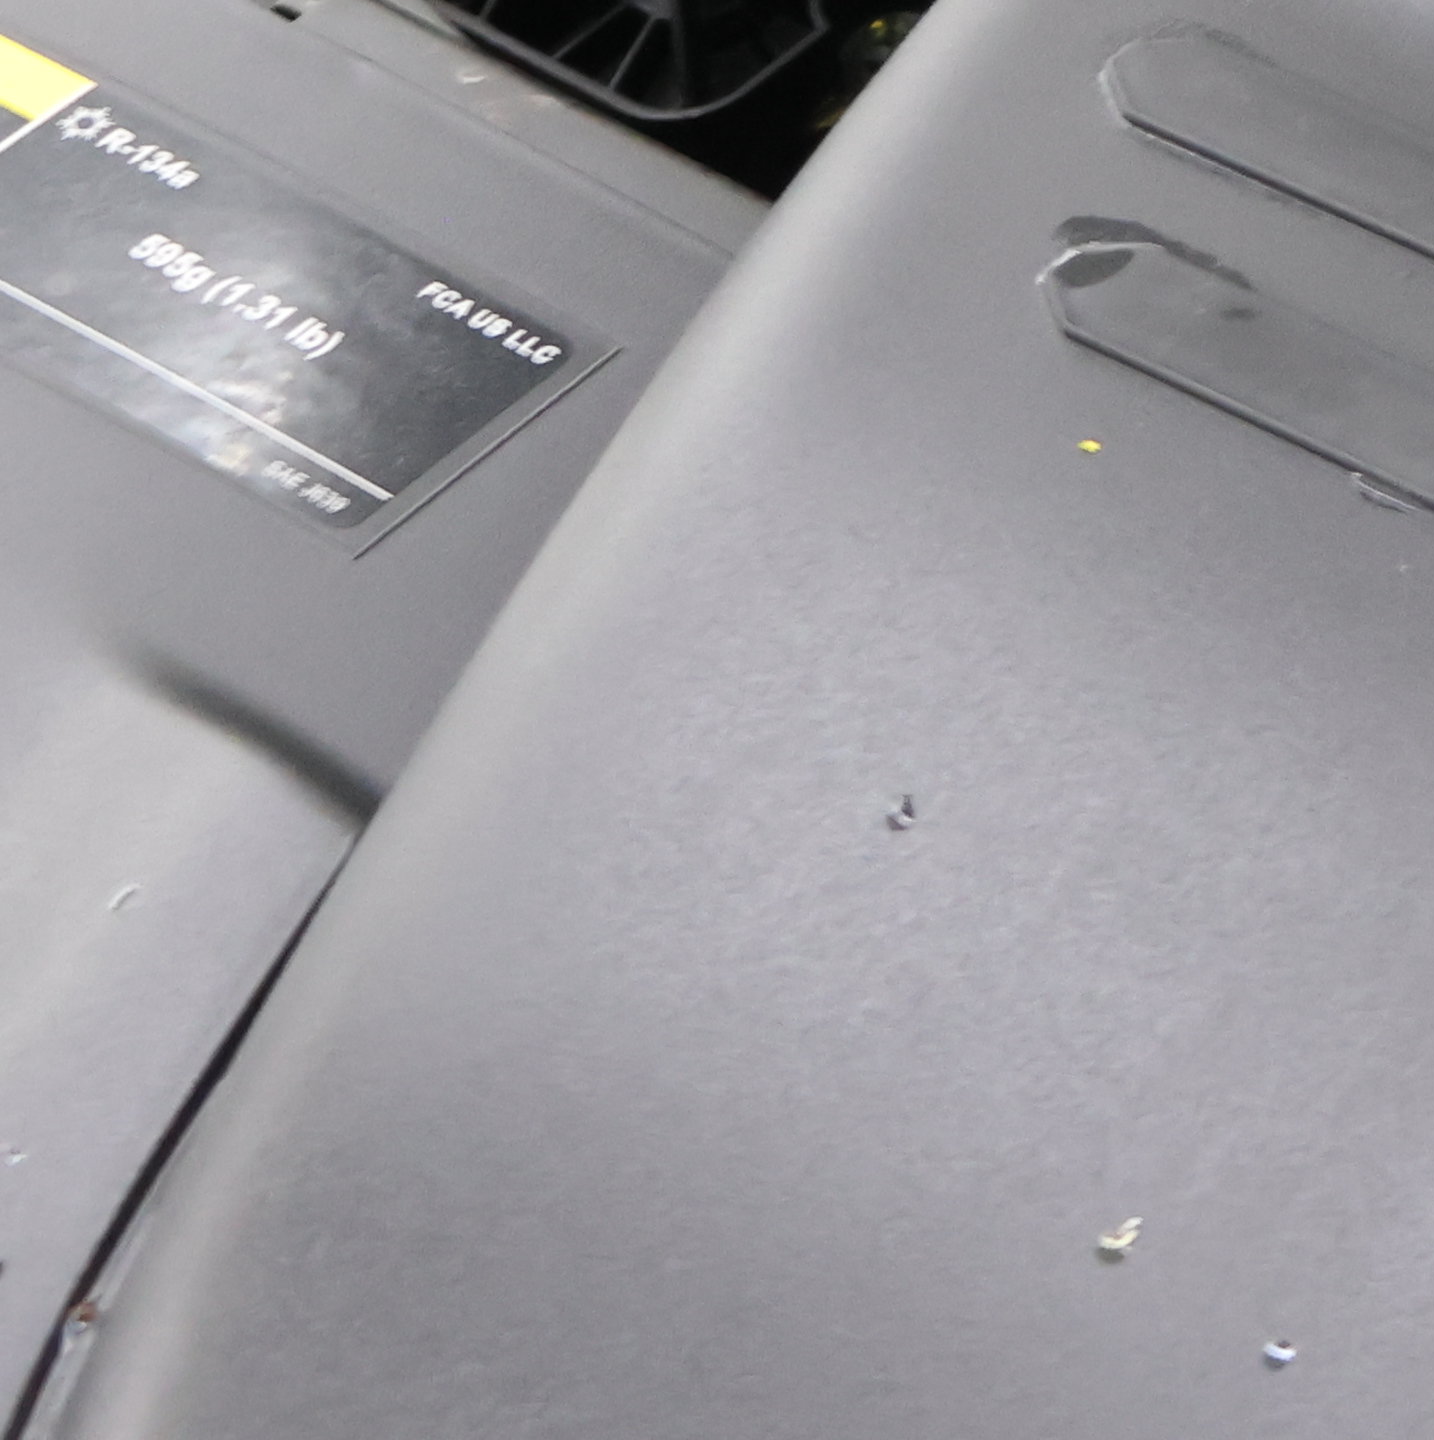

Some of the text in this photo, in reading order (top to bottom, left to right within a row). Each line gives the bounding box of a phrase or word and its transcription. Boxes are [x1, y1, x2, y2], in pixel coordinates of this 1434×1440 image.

[95, 127, 200, 190] R-134a
[127, 233, 346, 361] 595g (1.31 lb)
[416, 280, 476, 321] FCA
[501, 328, 563, 365] LLC
